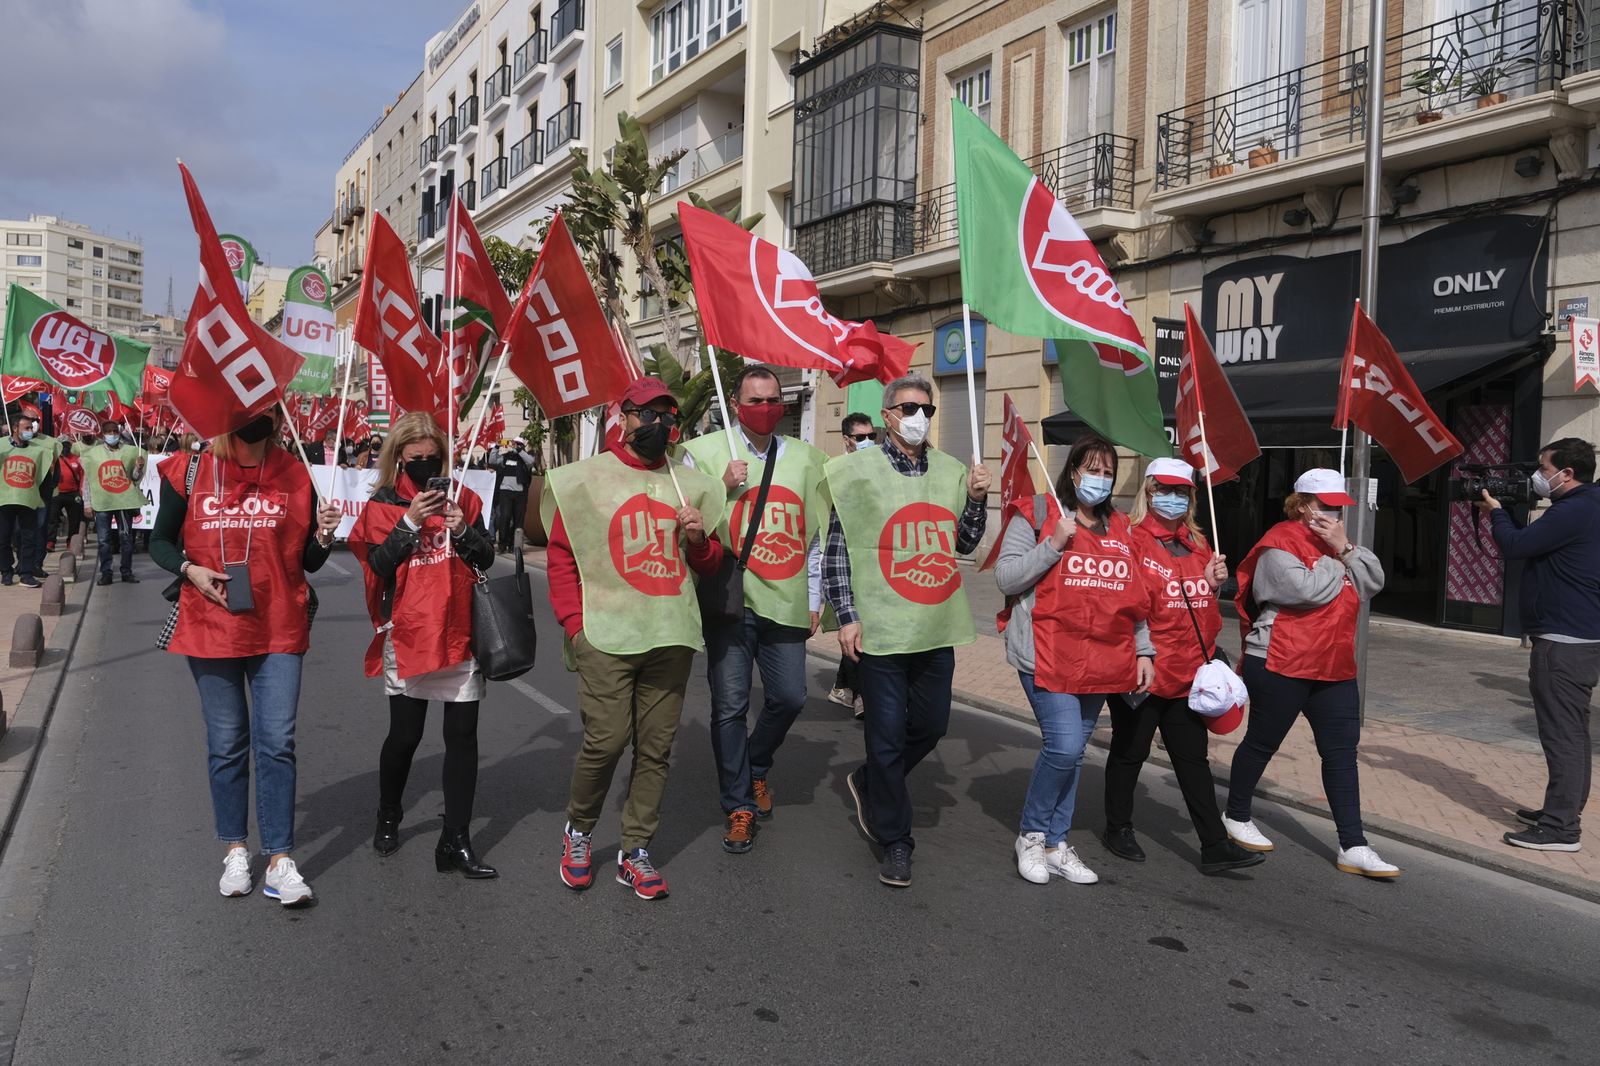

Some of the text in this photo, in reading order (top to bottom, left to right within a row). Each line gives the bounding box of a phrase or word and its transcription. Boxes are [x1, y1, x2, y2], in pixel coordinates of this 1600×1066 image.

[1433, 268, 1506, 297] ONLY
[1216, 272, 1285, 331] MY
[1433, 301, 1505, 314] PREMIUM DISTRIBUTOR
[40, 317, 109, 360] UGT
[286, 316, 335, 342] UGT
[1156, 328, 1187, 341] MY WA
[1216, 325, 1283, 364] WAY
[7, 460, 35, 477] UGT
[201, 517, 277, 530] andalucía
[893, 520, 957, 562] UGT
[1101, 539, 1130, 554] CCOO
[1064, 578, 1125, 591] andalucía
